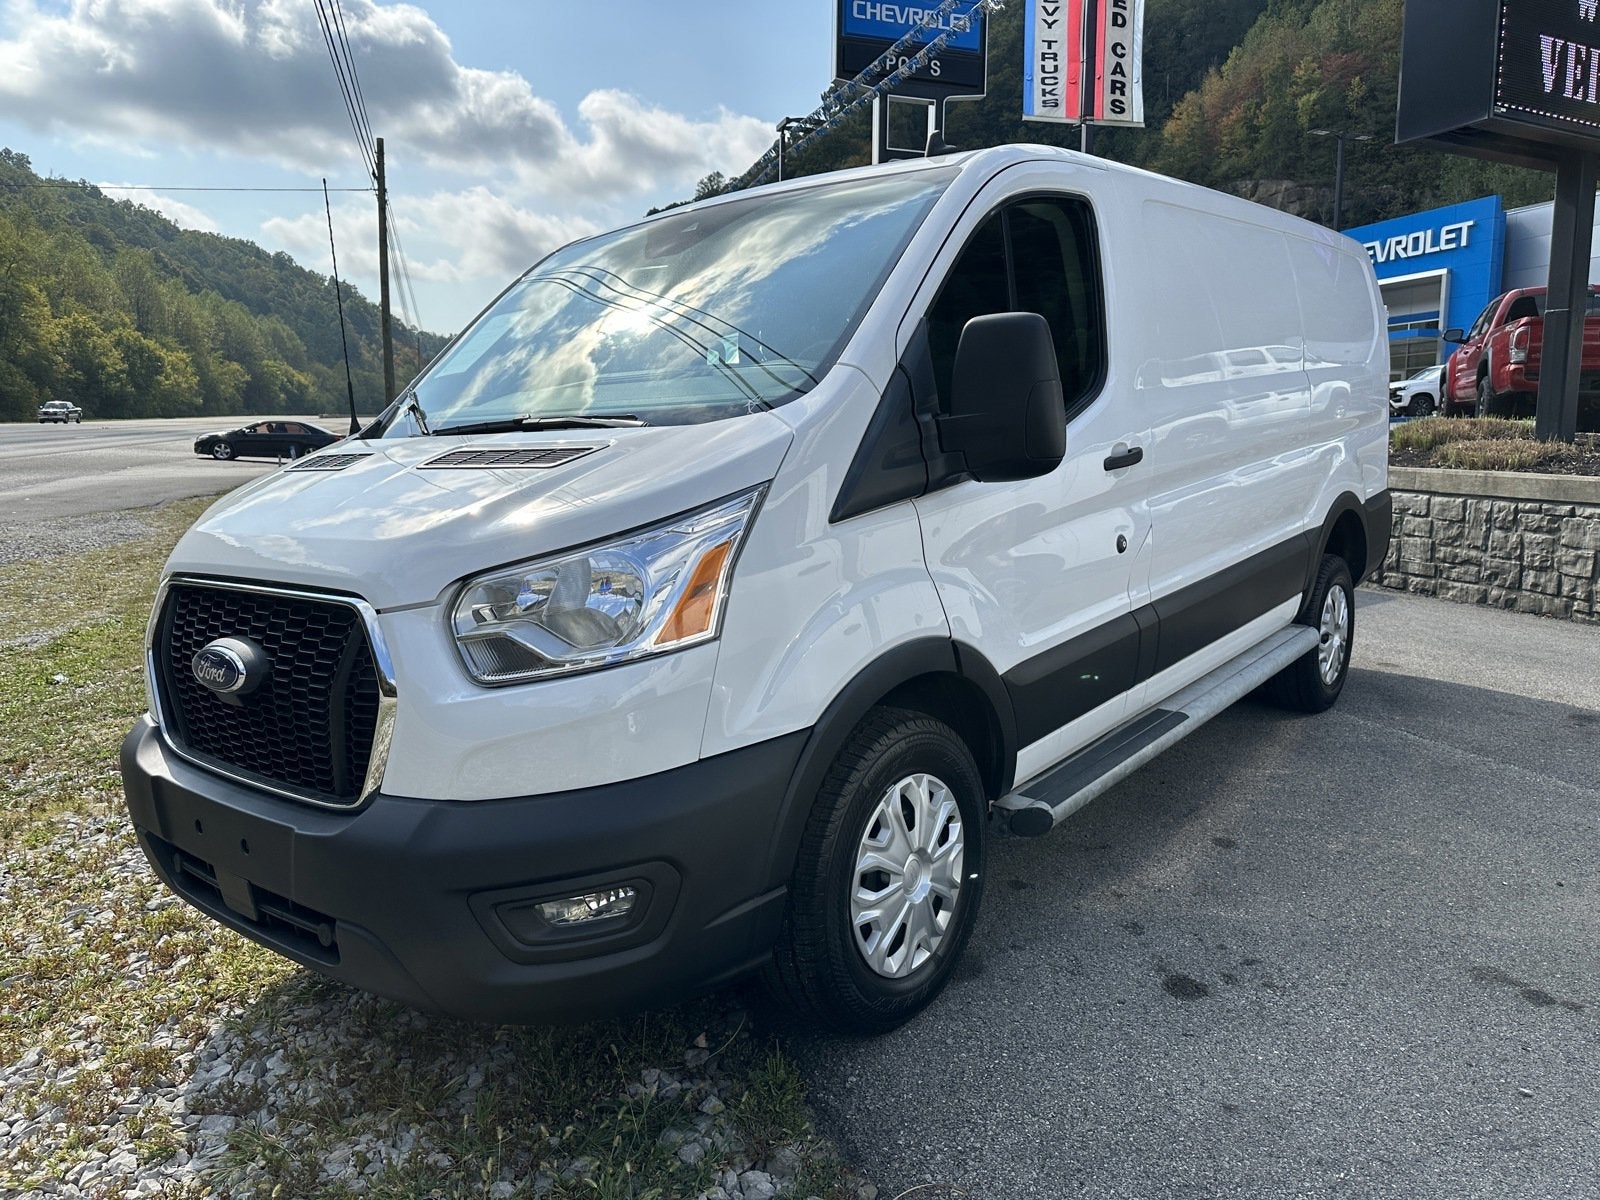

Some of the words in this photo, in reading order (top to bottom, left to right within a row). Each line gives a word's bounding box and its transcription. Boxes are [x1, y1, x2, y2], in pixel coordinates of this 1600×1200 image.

[1040, 39, 1059, 108] TRUCKS
[1109, 41, 1127, 115] CARS
[198, 653, 227, 682] Ford
